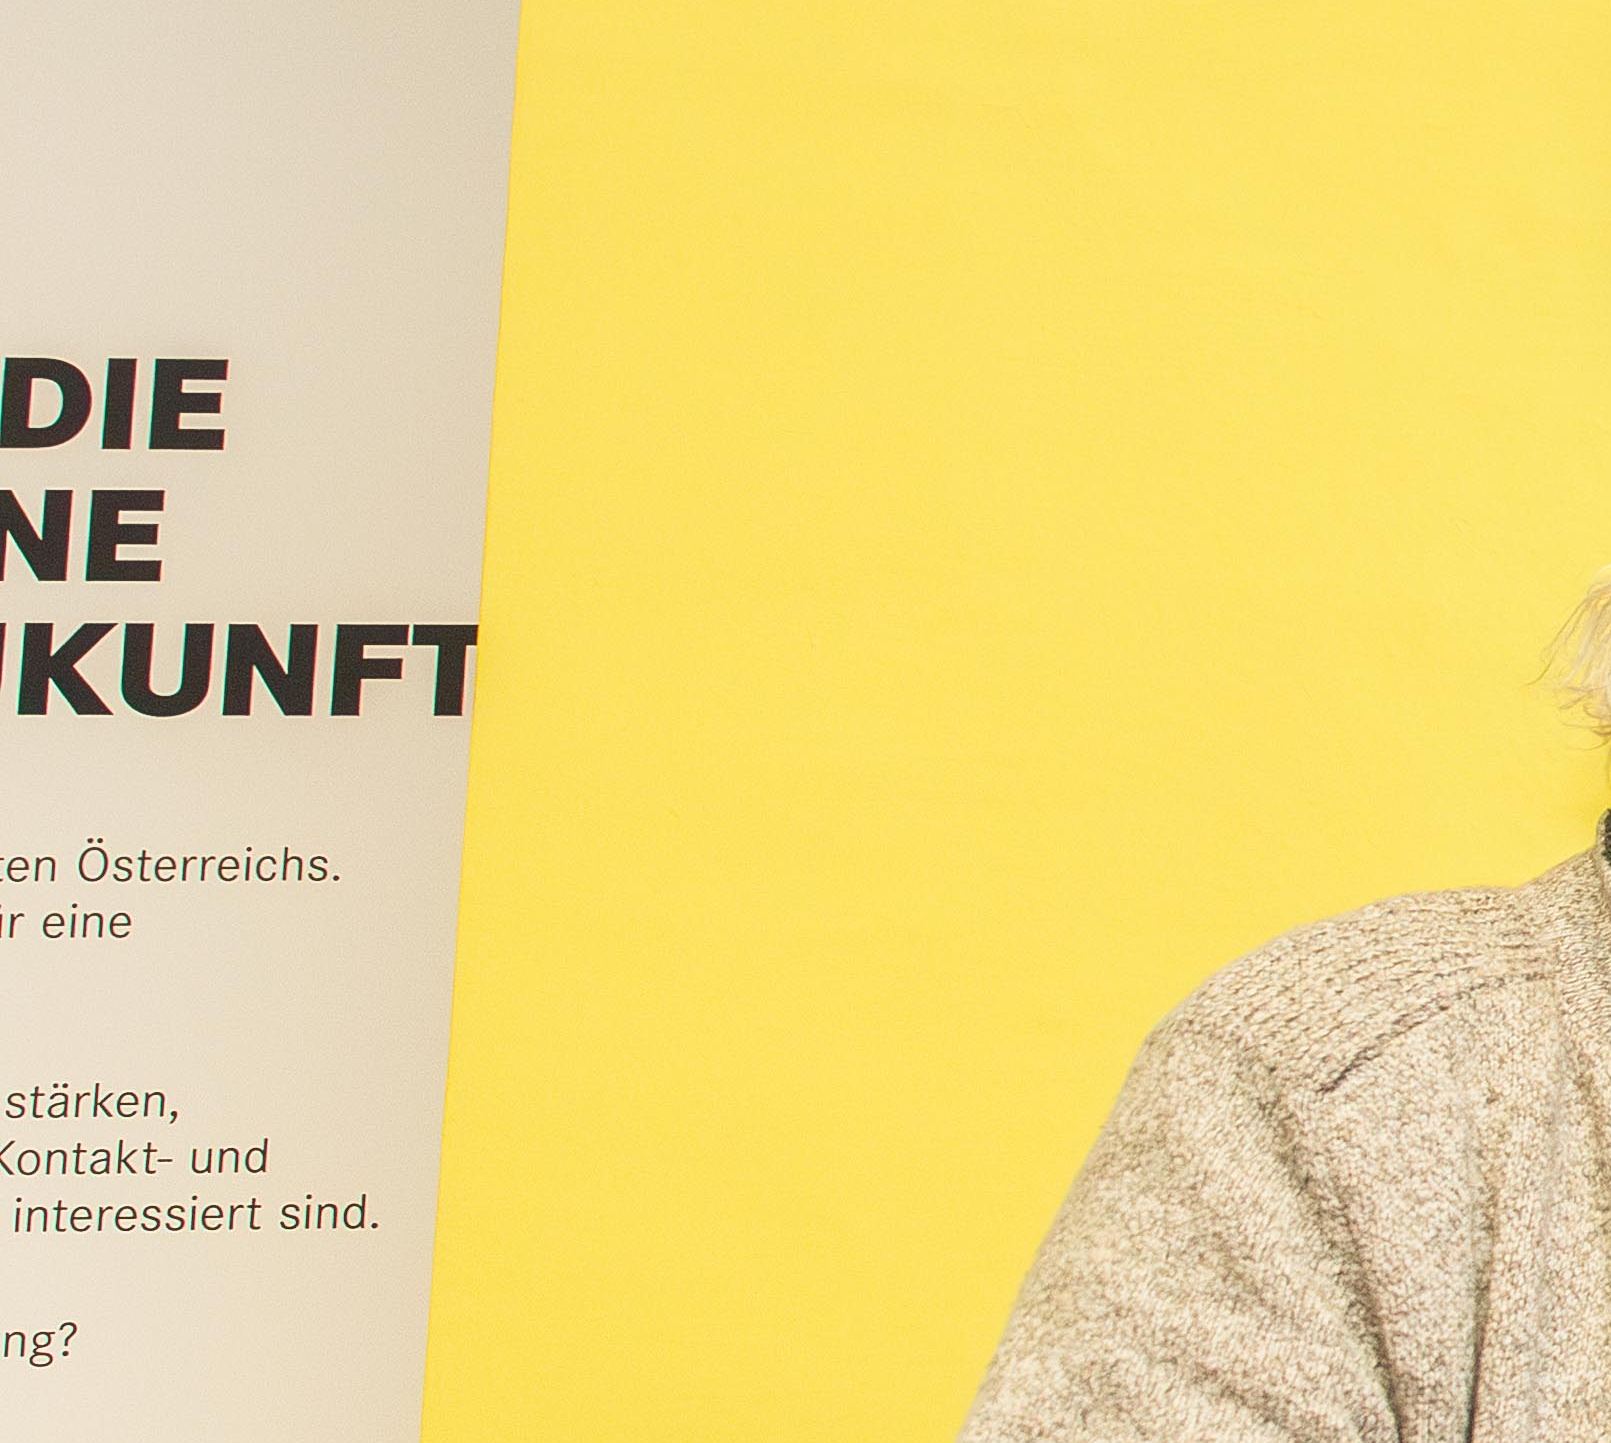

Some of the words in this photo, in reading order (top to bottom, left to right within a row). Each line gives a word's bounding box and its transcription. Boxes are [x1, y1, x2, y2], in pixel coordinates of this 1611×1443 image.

[0, 357, 229, 450] DIE
[0, 623, 480, 717] KUNFT
[0, 855, 57, 883] en
[78, 837, 341, 883] Österreichs.
[42, 903, 132, 939] eine
[5, 1082, 179, 1124] stärken,
[191, 1137, 269, 1174] und
[14, 1194, 262, 1233] interessiert
[279, 1193, 380, 1230] sind.
